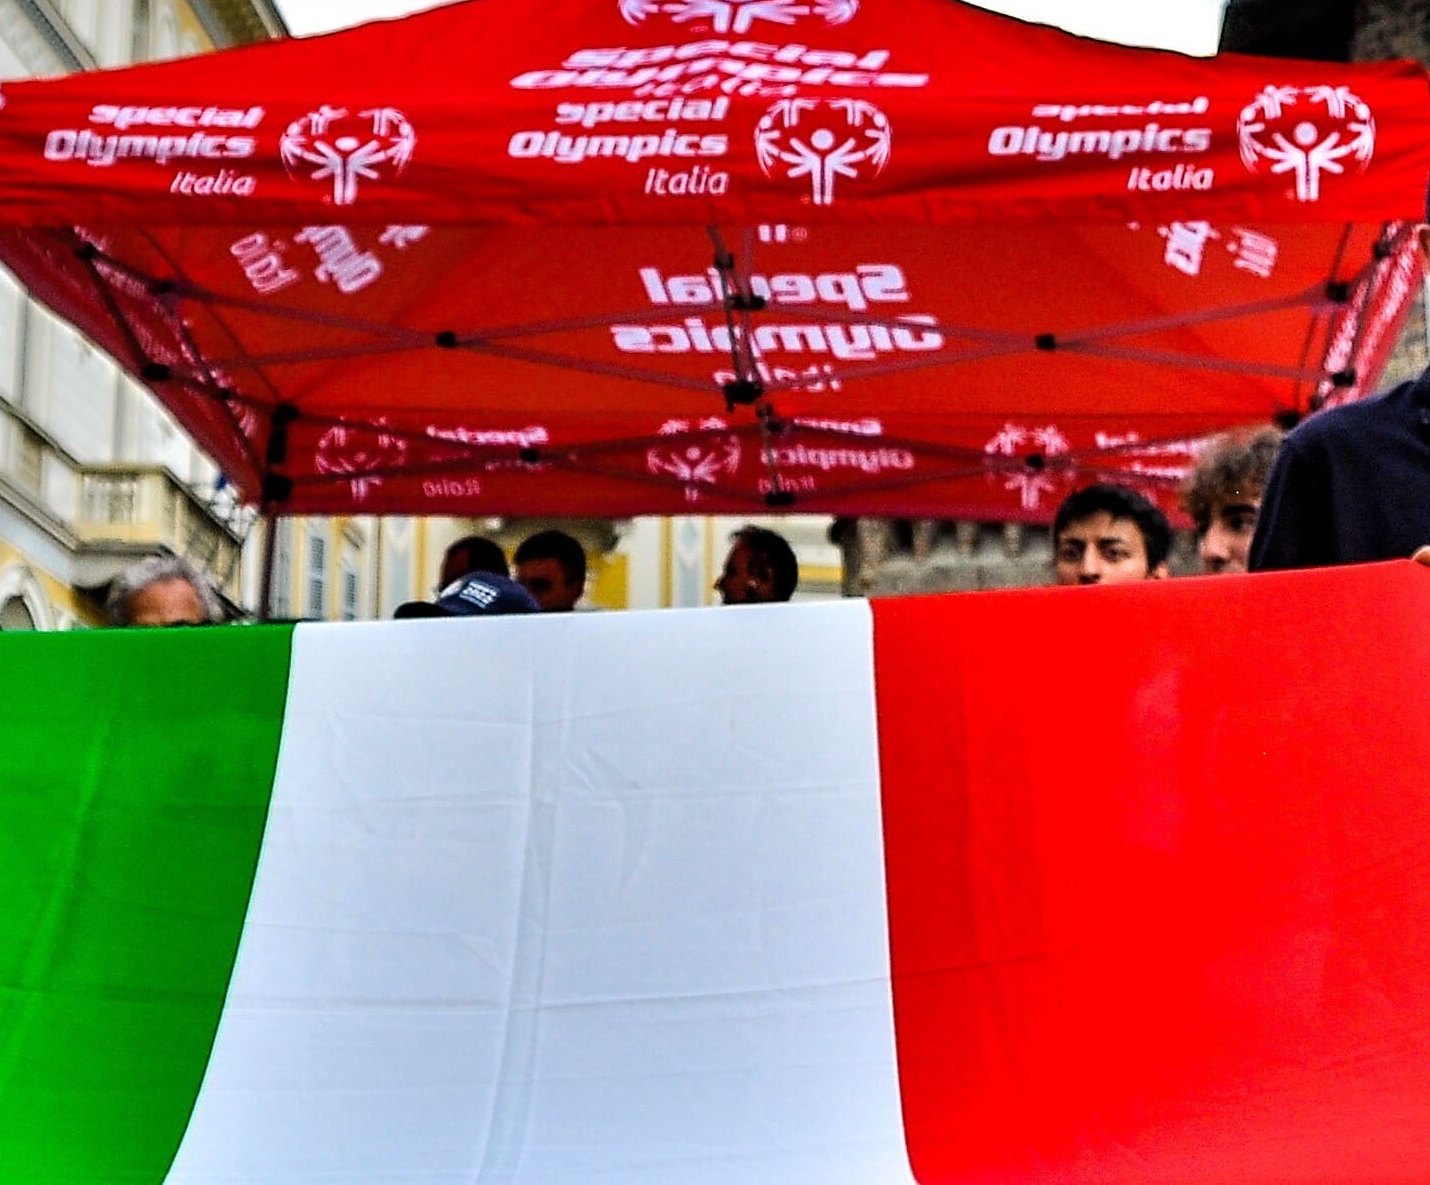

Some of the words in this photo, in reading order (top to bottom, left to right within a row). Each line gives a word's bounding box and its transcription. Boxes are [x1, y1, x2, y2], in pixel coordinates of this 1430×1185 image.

[555, 96, 730, 127] Special
[44, 129, 257, 166] Olympics
[508, 127, 730, 163] Olympics
[988, 123, 1212, 161] Olympics
[170, 169, 257, 196] Italia
[644, 165, 730, 195] Italia
[1127, 164, 1214, 191] Italia
